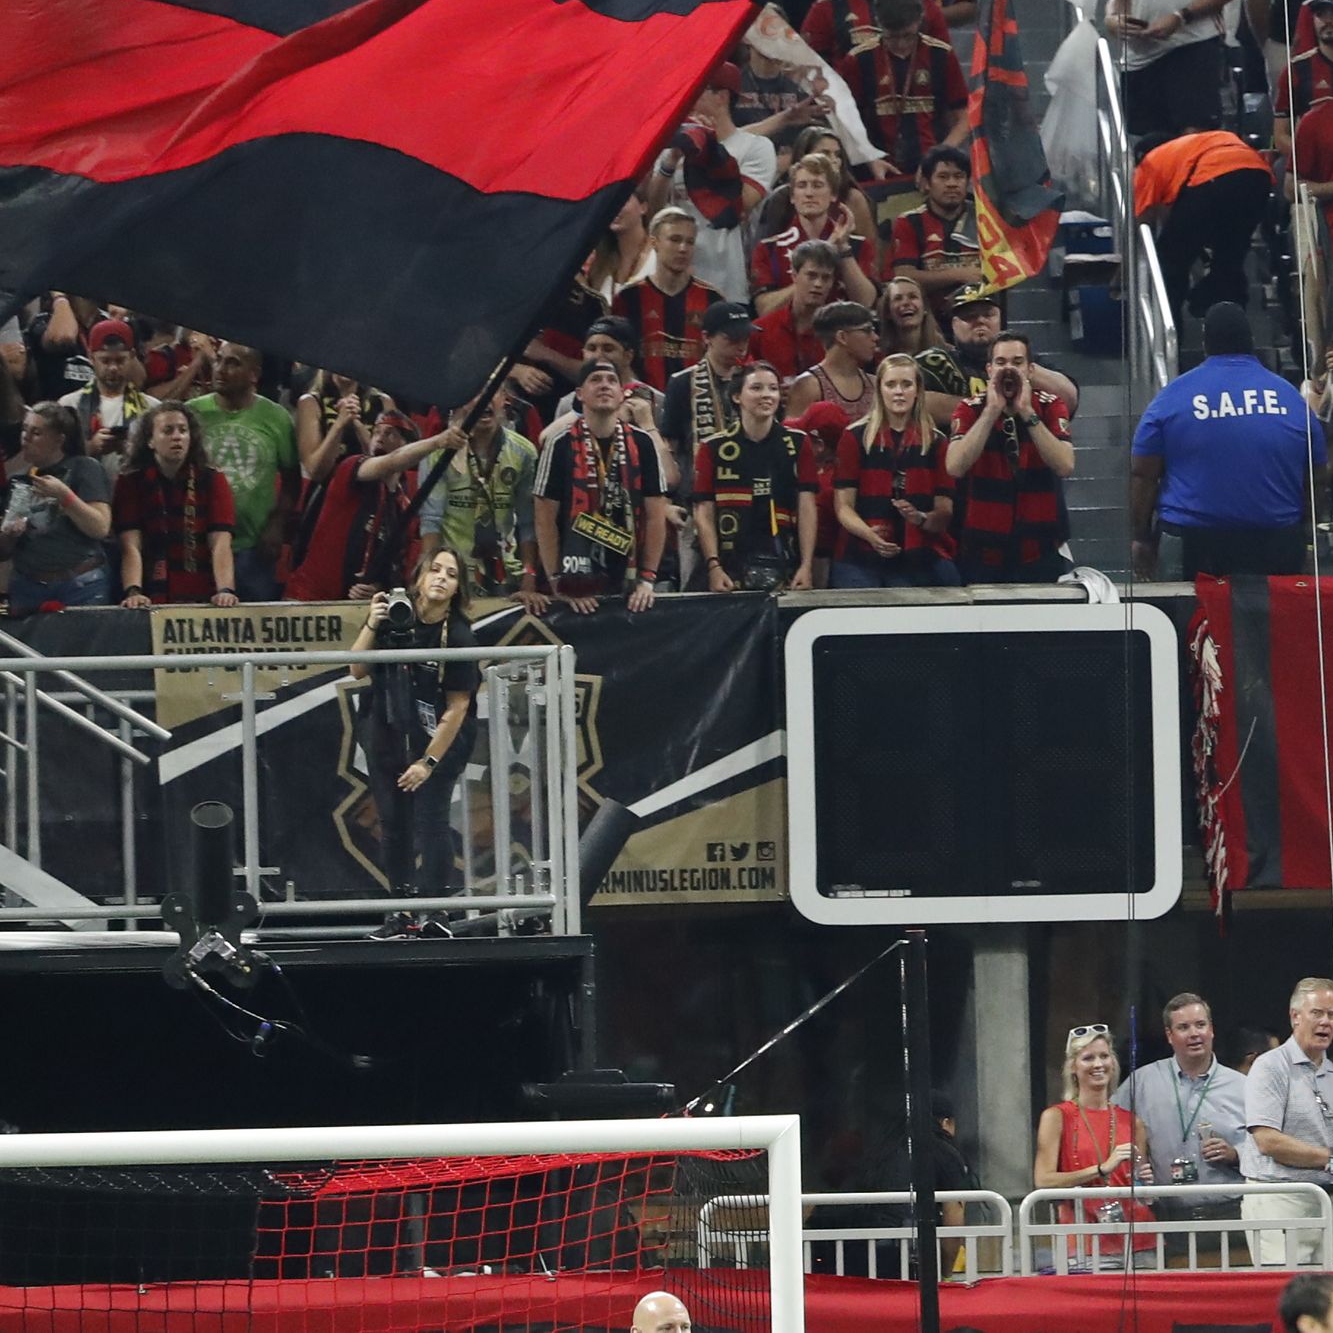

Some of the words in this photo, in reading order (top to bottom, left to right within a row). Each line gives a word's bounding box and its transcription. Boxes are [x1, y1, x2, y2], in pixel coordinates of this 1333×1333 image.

[1193, 391, 1288, 421] S.A.F.E.
[163, 617, 256, 644] ATLANTA
[260, 615, 343, 642] SOCCER
[597, 867, 776, 895] RMINUSLEGION.COM
